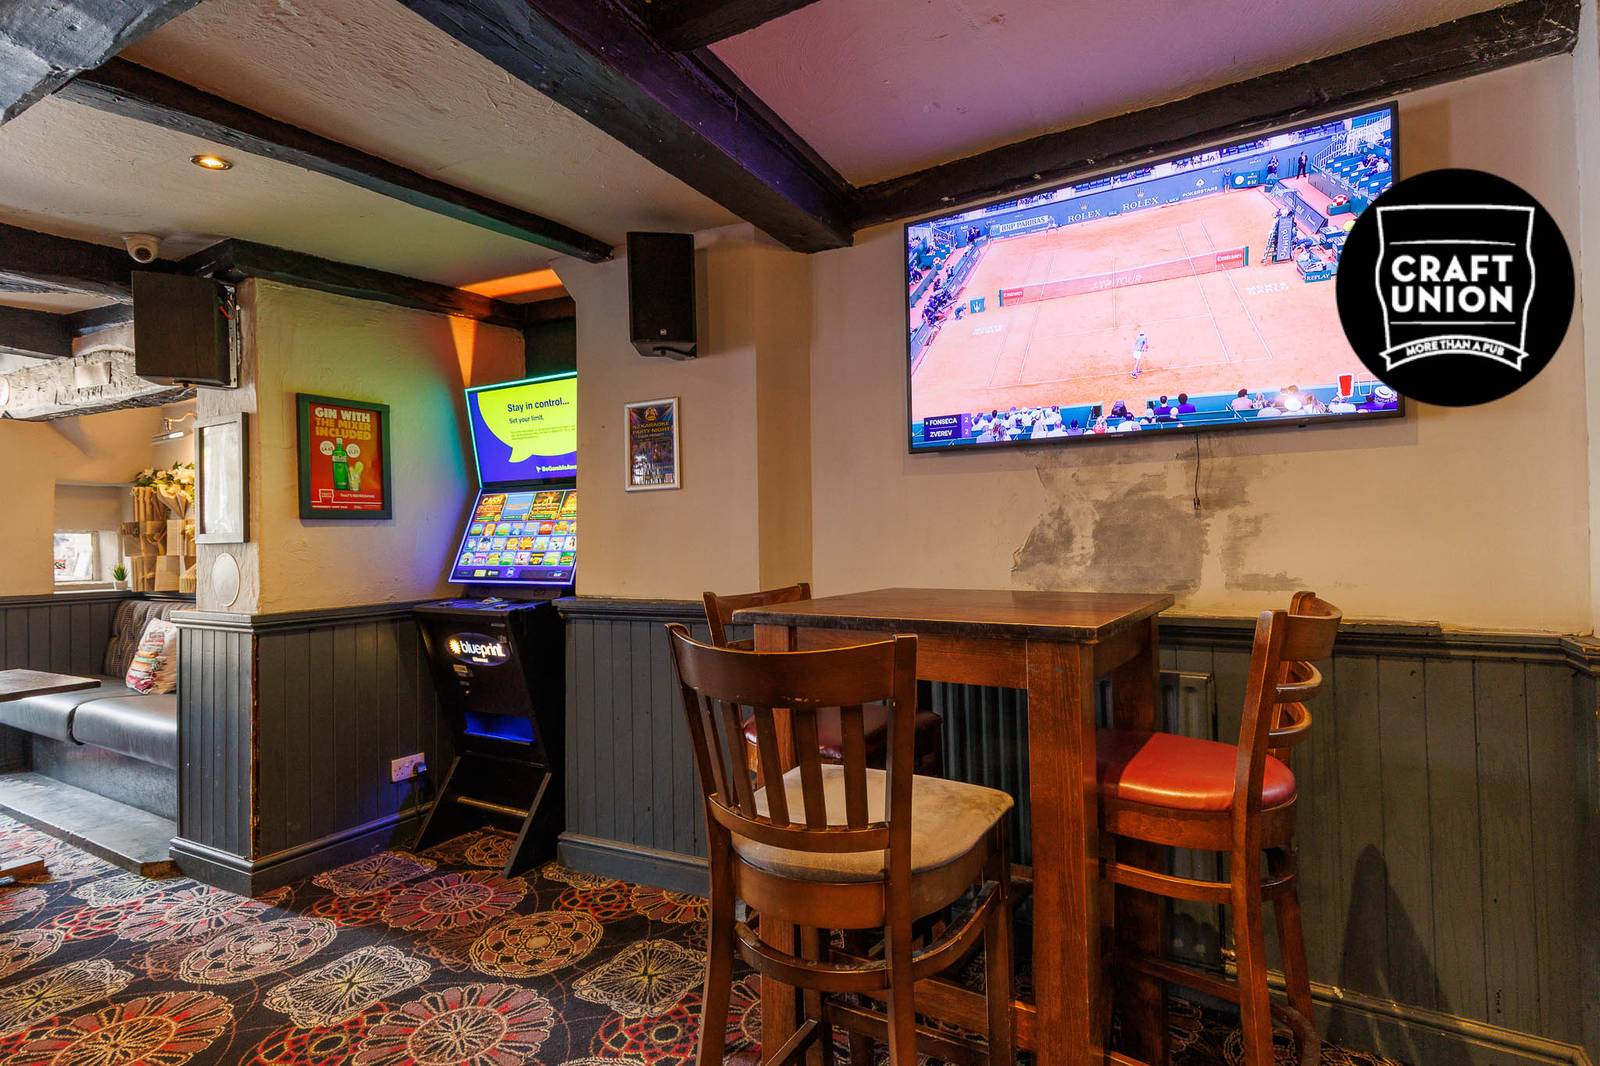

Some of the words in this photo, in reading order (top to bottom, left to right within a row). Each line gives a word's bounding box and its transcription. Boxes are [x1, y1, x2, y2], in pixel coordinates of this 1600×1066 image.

[1123, 197, 1159, 210] ROLEX
[1068, 209, 1101, 222] ROLEX
[508, 404, 524, 412] Stay
[535, 397, 569, 408] control...
[315, 407, 337, 419] GIN
[341, 410, 370, 422] WITH
[316, 418, 334, 427] THE
[338, 419, 371, 431] MIXER
[930, 418, 957, 426] FONSECA
[315, 426, 371, 440] INCLUDED
[460, 640, 504, 657] blueprint
